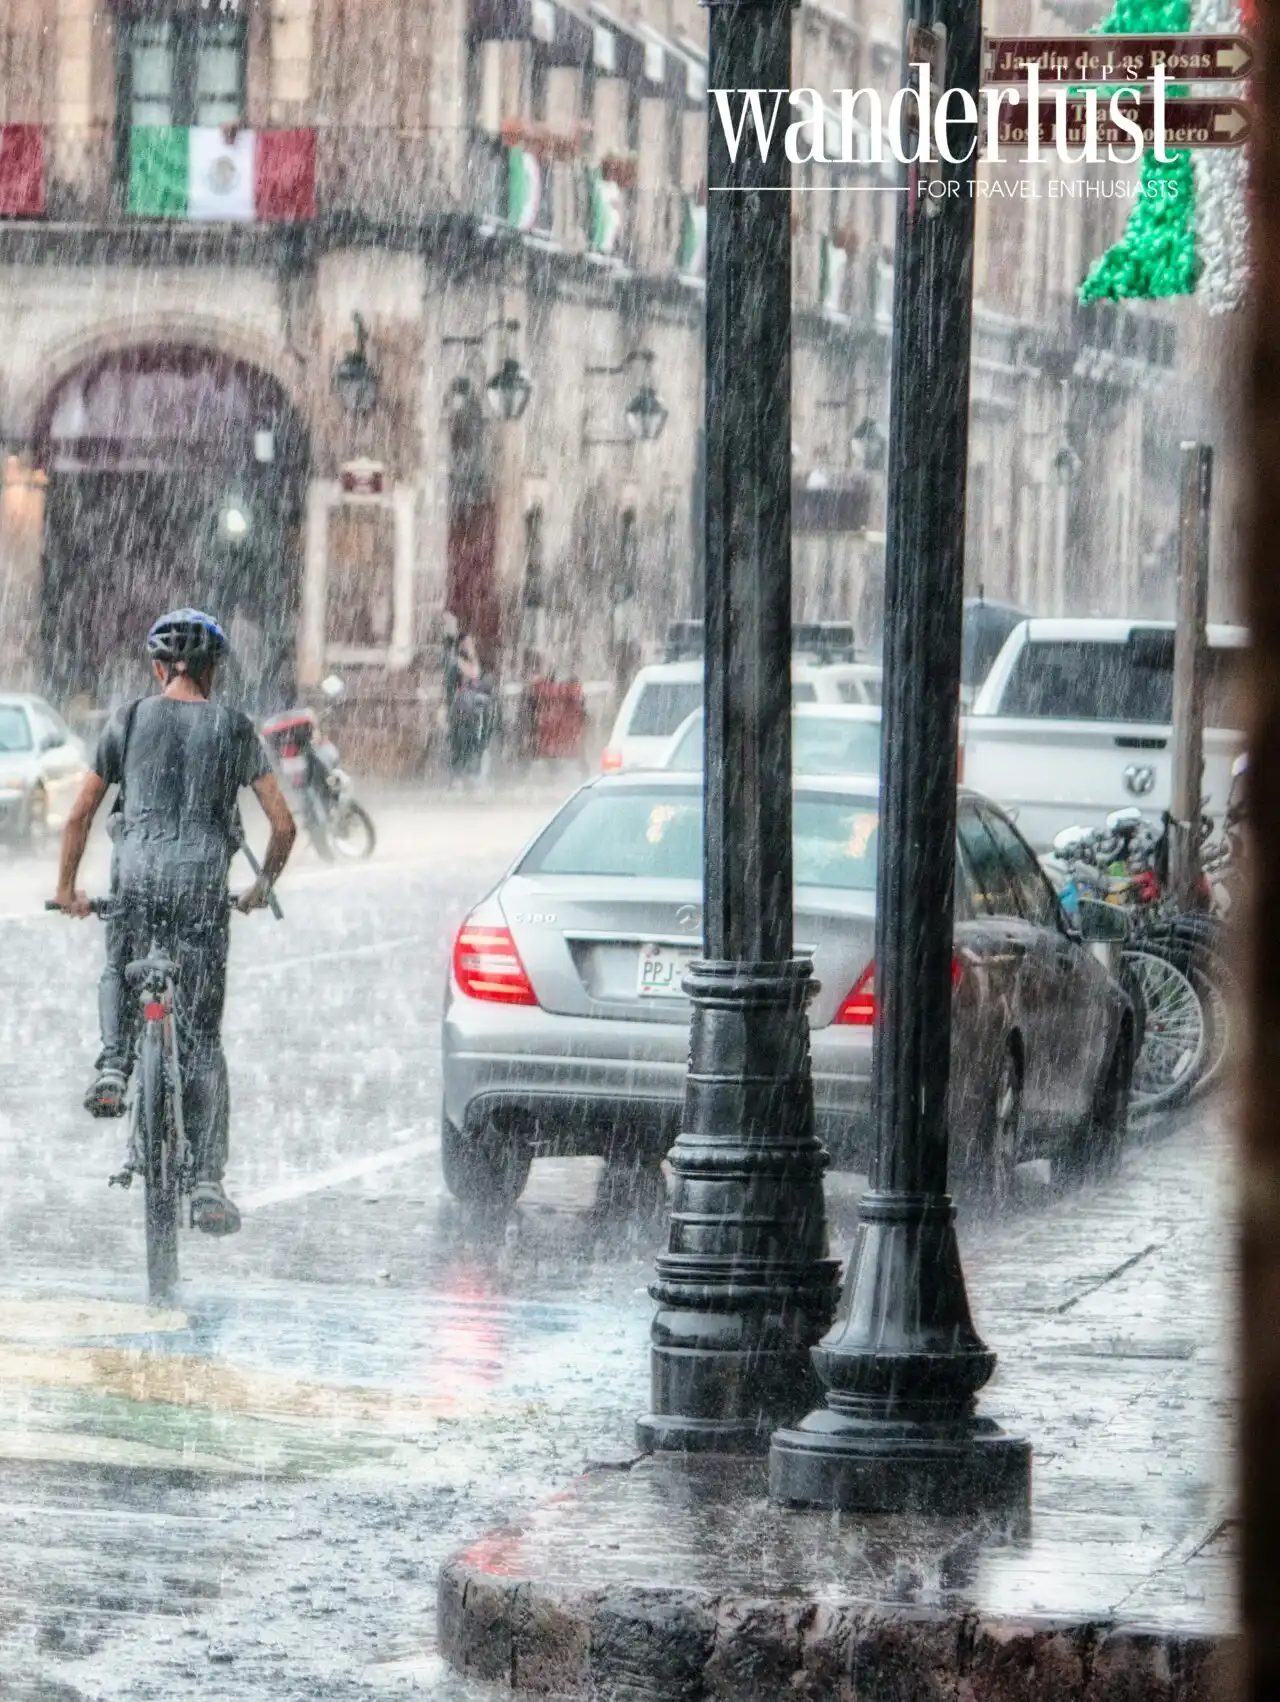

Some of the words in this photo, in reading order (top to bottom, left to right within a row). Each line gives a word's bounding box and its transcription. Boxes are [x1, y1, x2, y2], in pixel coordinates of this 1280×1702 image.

[1000, 51, 1068, 70] Jardín
[1075, 51, 1100, 69] de
[1104, 50, 1144, 69] Las
[1150, 49, 1211, 69] Rosas
[1071, 104, 1139, 121] Tao
[1126, 123, 1209, 141] omero
